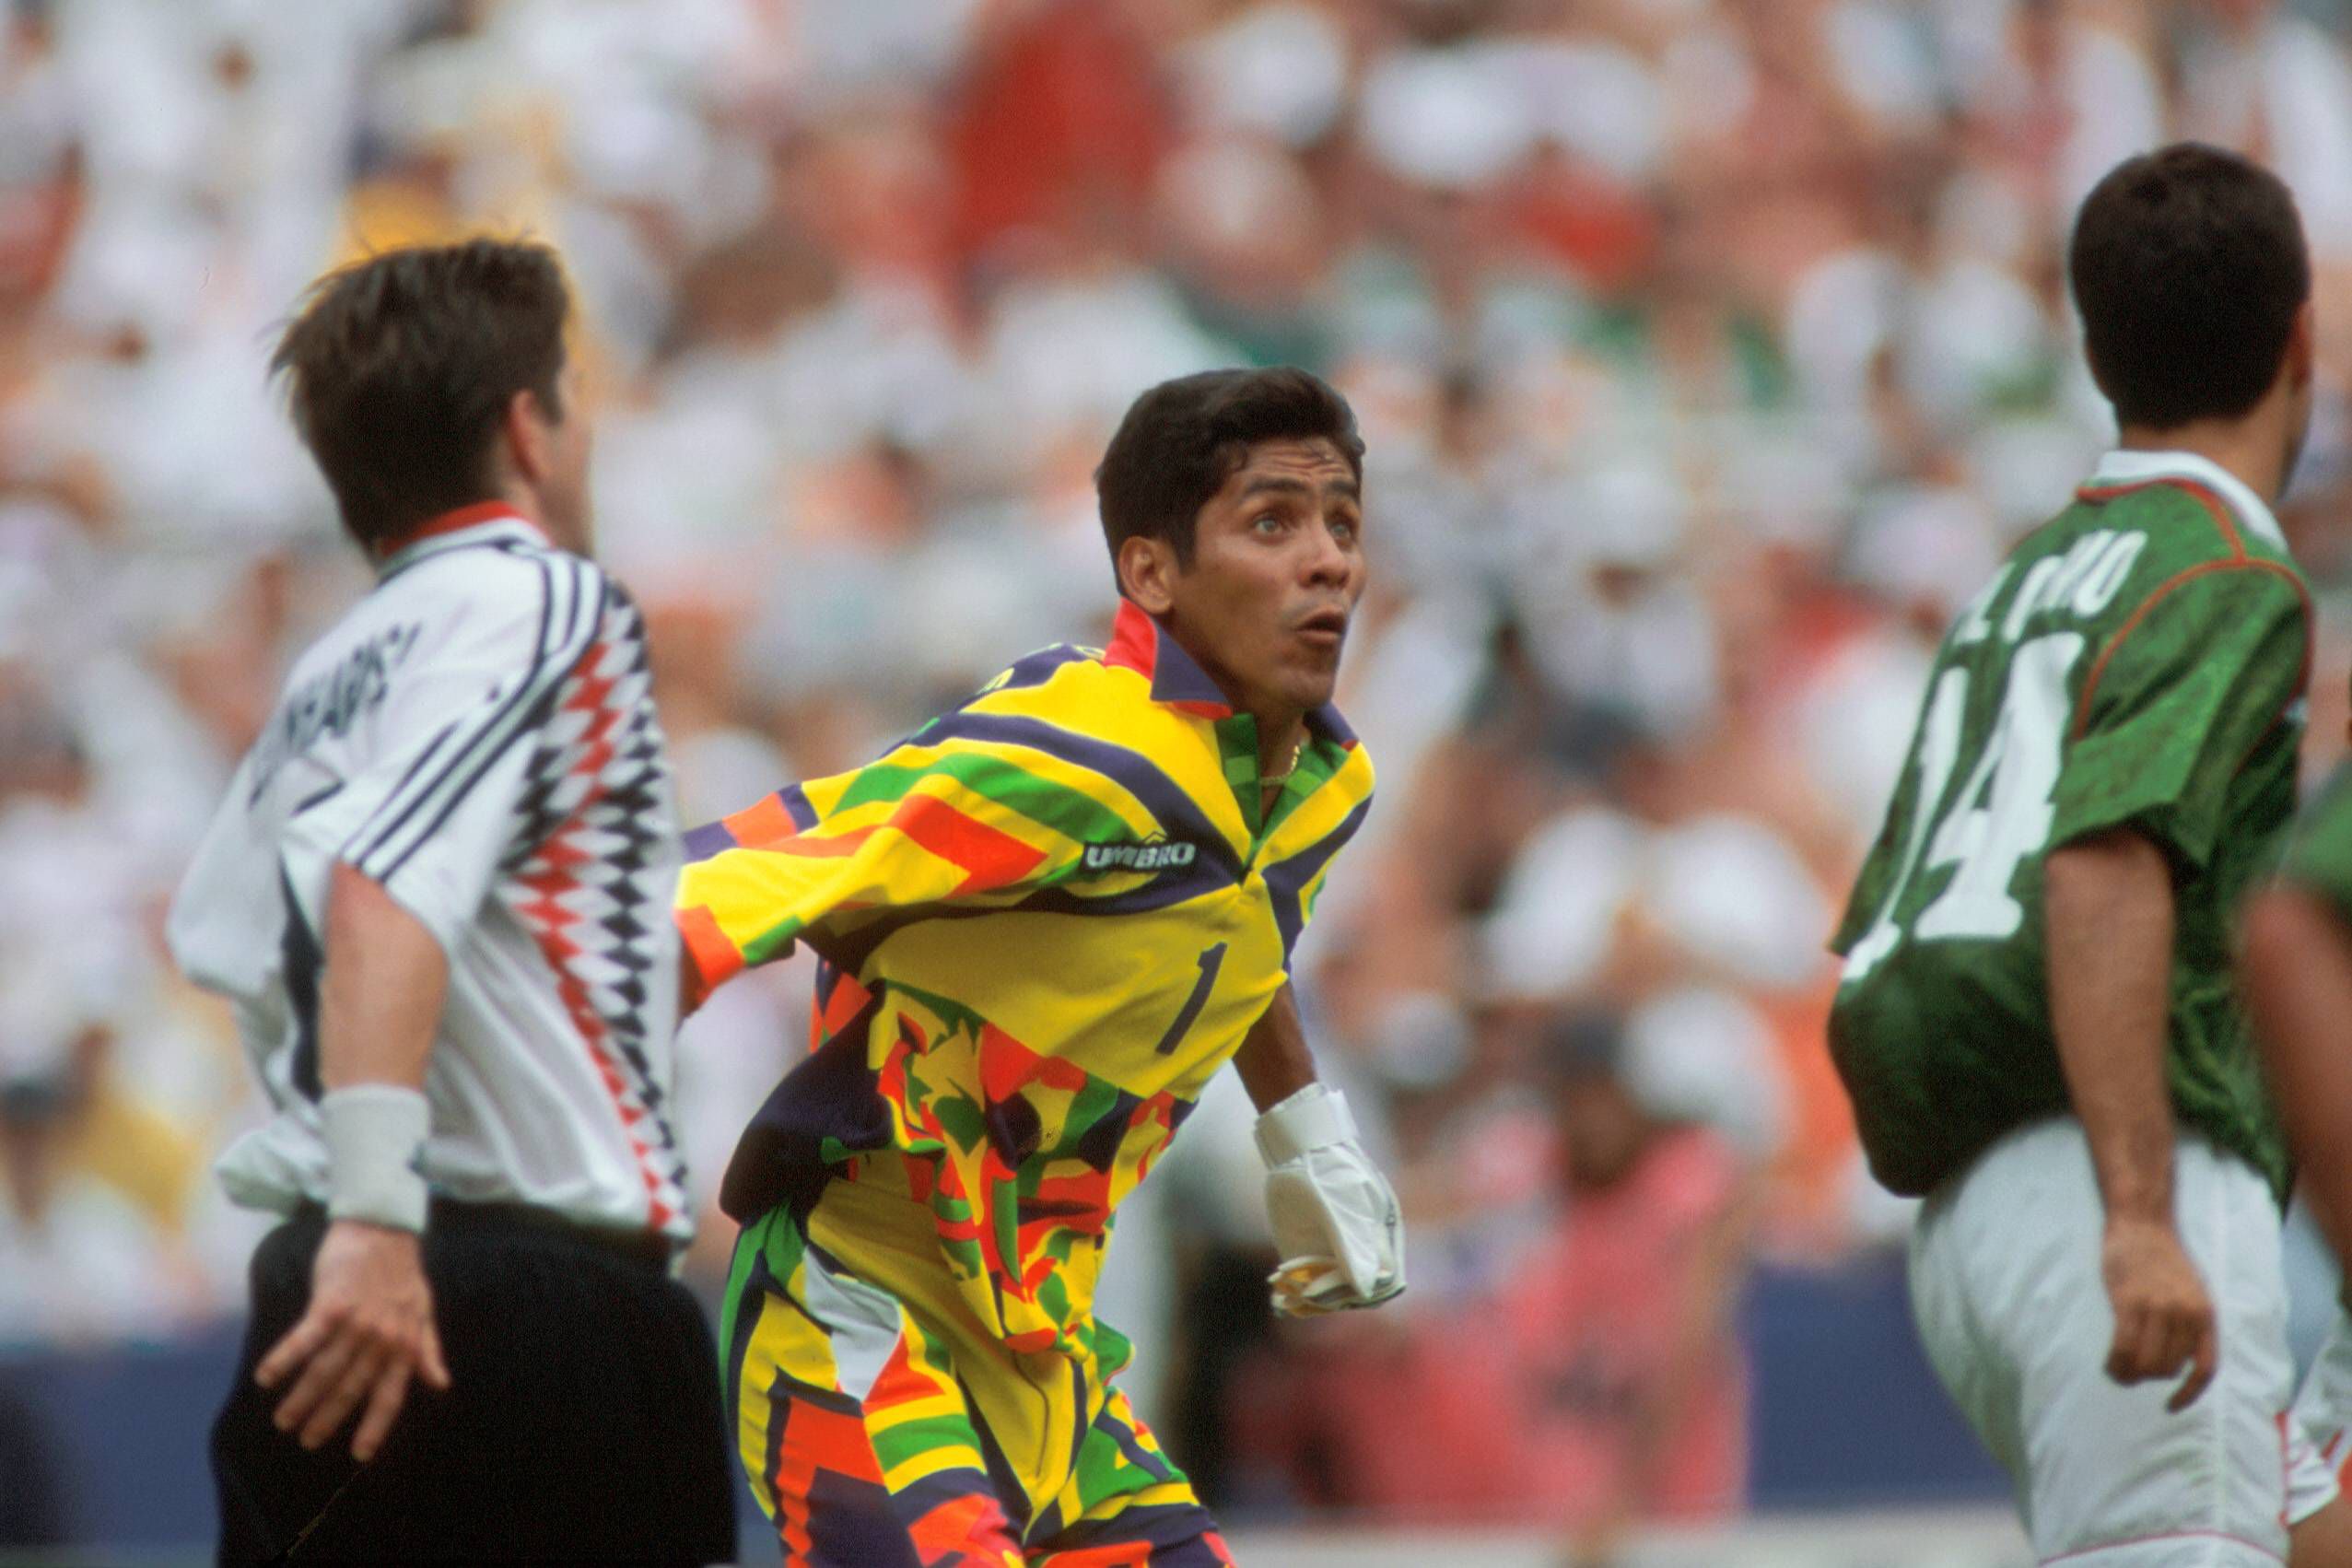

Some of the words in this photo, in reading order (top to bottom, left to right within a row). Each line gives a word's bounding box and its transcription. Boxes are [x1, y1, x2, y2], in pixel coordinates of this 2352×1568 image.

[1085, 842, 1197, 868] UMBRO
[1843, 632, 2085, 980] 14
[1154, 941, 1228, 1056] 1
